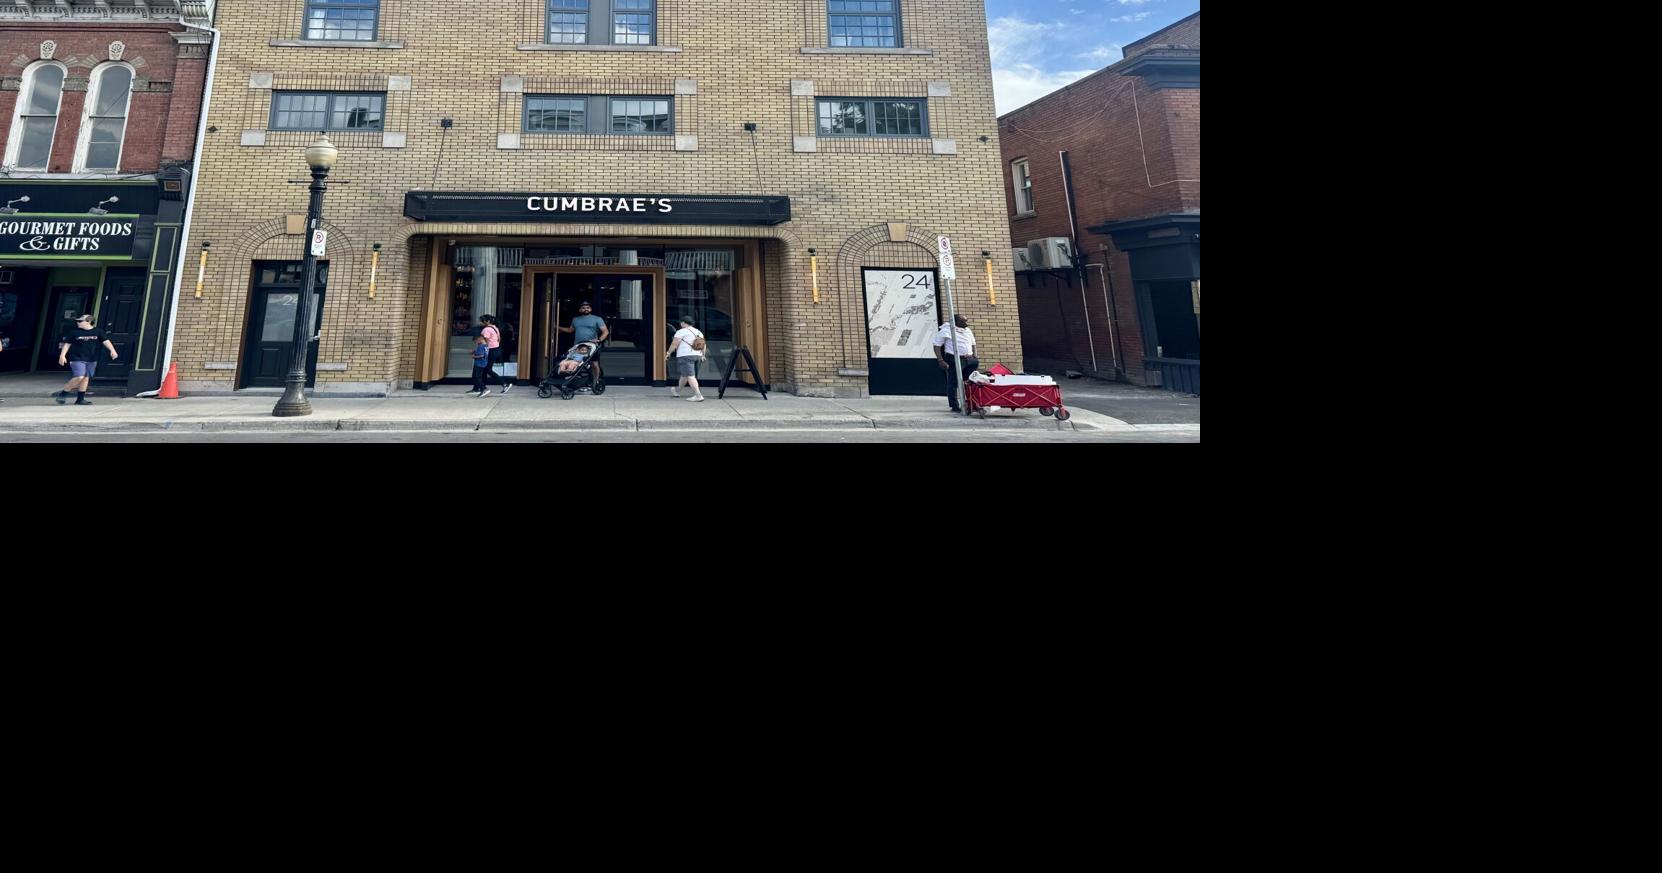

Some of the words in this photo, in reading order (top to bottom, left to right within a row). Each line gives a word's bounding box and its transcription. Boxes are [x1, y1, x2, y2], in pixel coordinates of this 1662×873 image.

[527, 196, 673, 213] CUMBRAE'S
[0, 221, 76, 235] GOURMET
[79, 222, 132, 236] FOODS
[19, 235, 51, 251] &
[53, 237, 100, 251] GIFTS
[901, 273, 931, 290] 24
